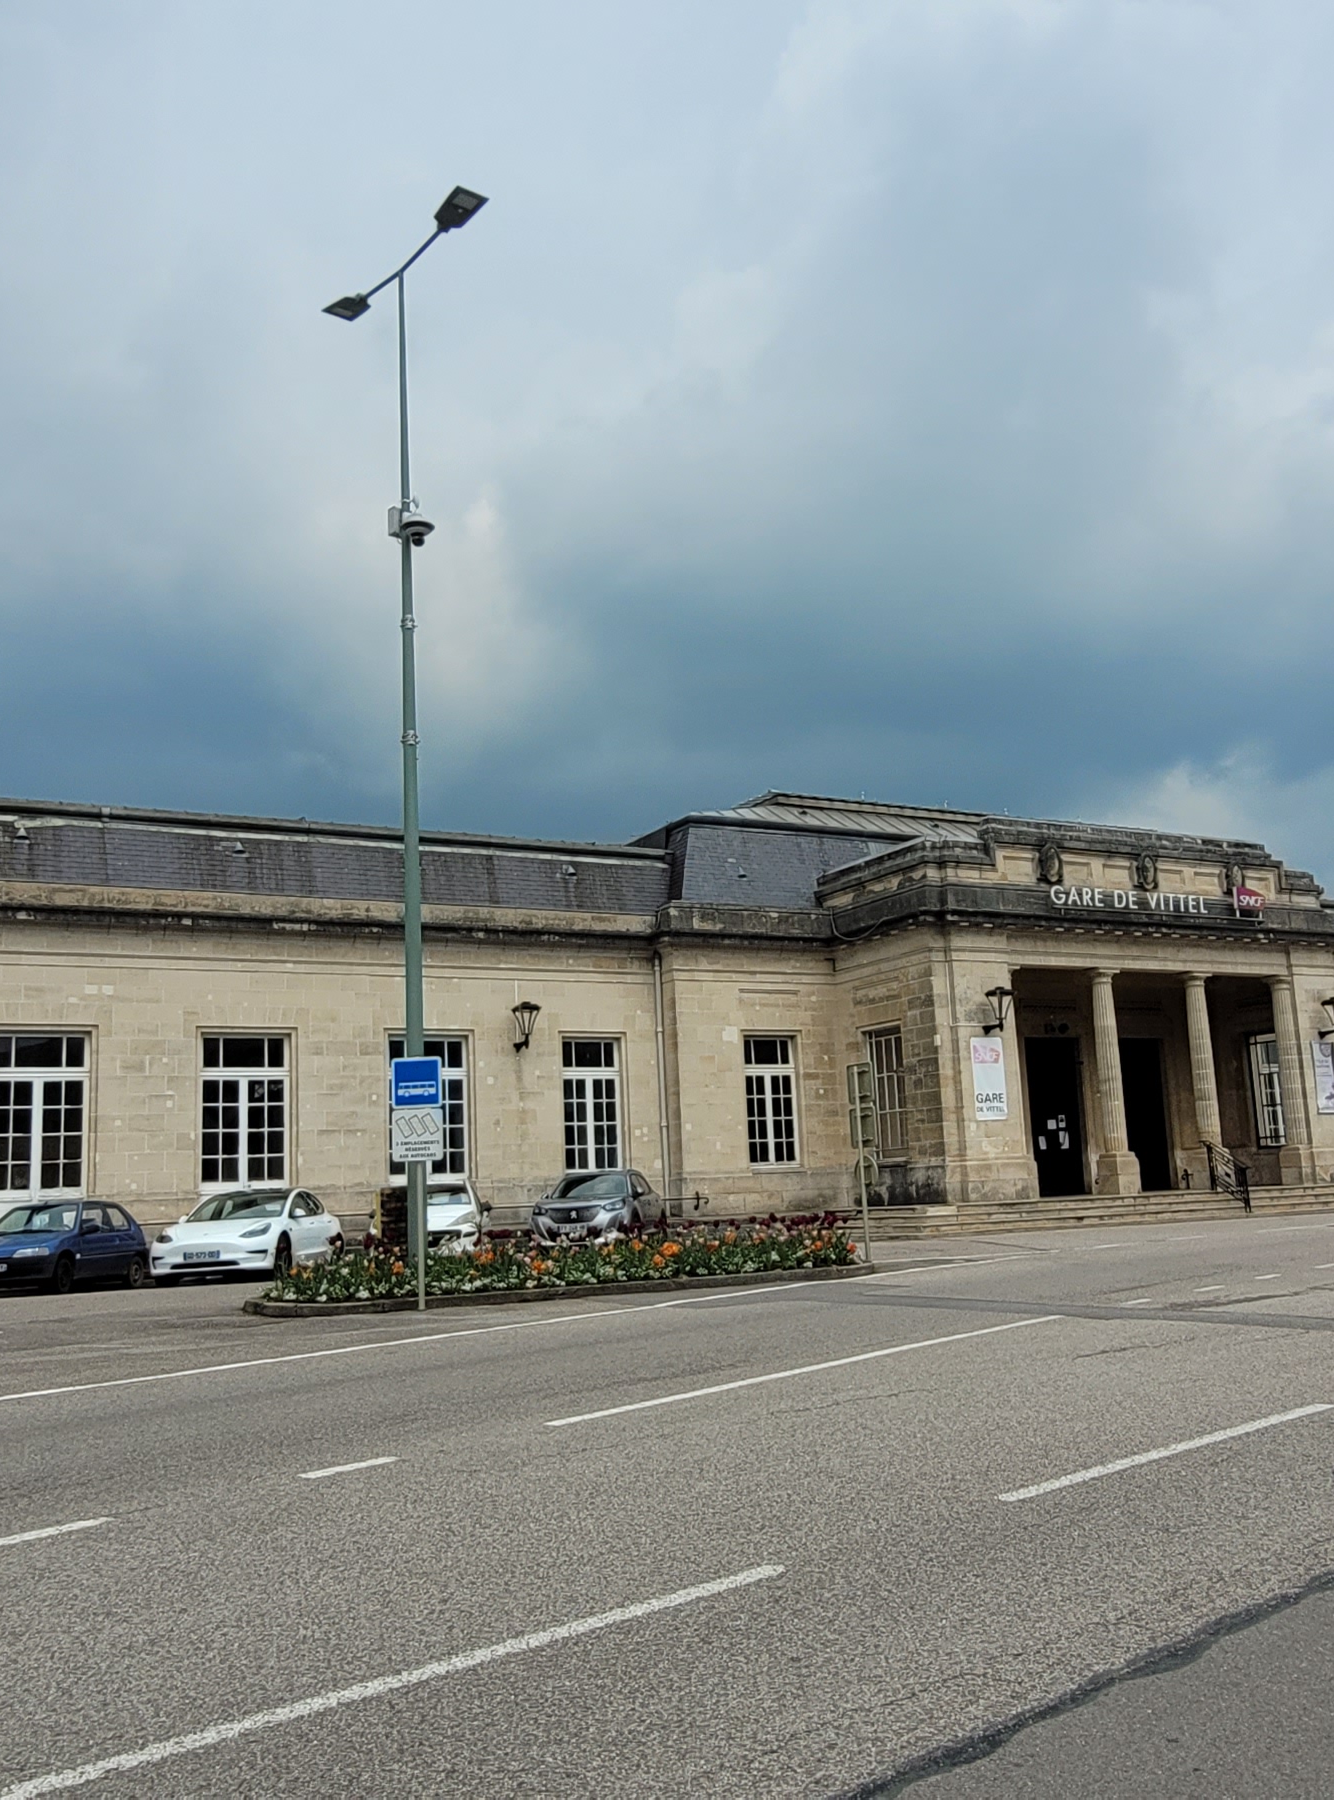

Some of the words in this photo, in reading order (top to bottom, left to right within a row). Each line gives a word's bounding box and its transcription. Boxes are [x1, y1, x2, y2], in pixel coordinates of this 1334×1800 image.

[1050, 885, 1105, 908] GARE
[1113, 889, 1139, 910] DE
[1146, 892, 1209, 914] VITTEL
[1238, 894, 1266, 908] SNCF
[975, 1092, 1005, 1104] GARE
[985, 1105, 1005, 1113] VITTEL
